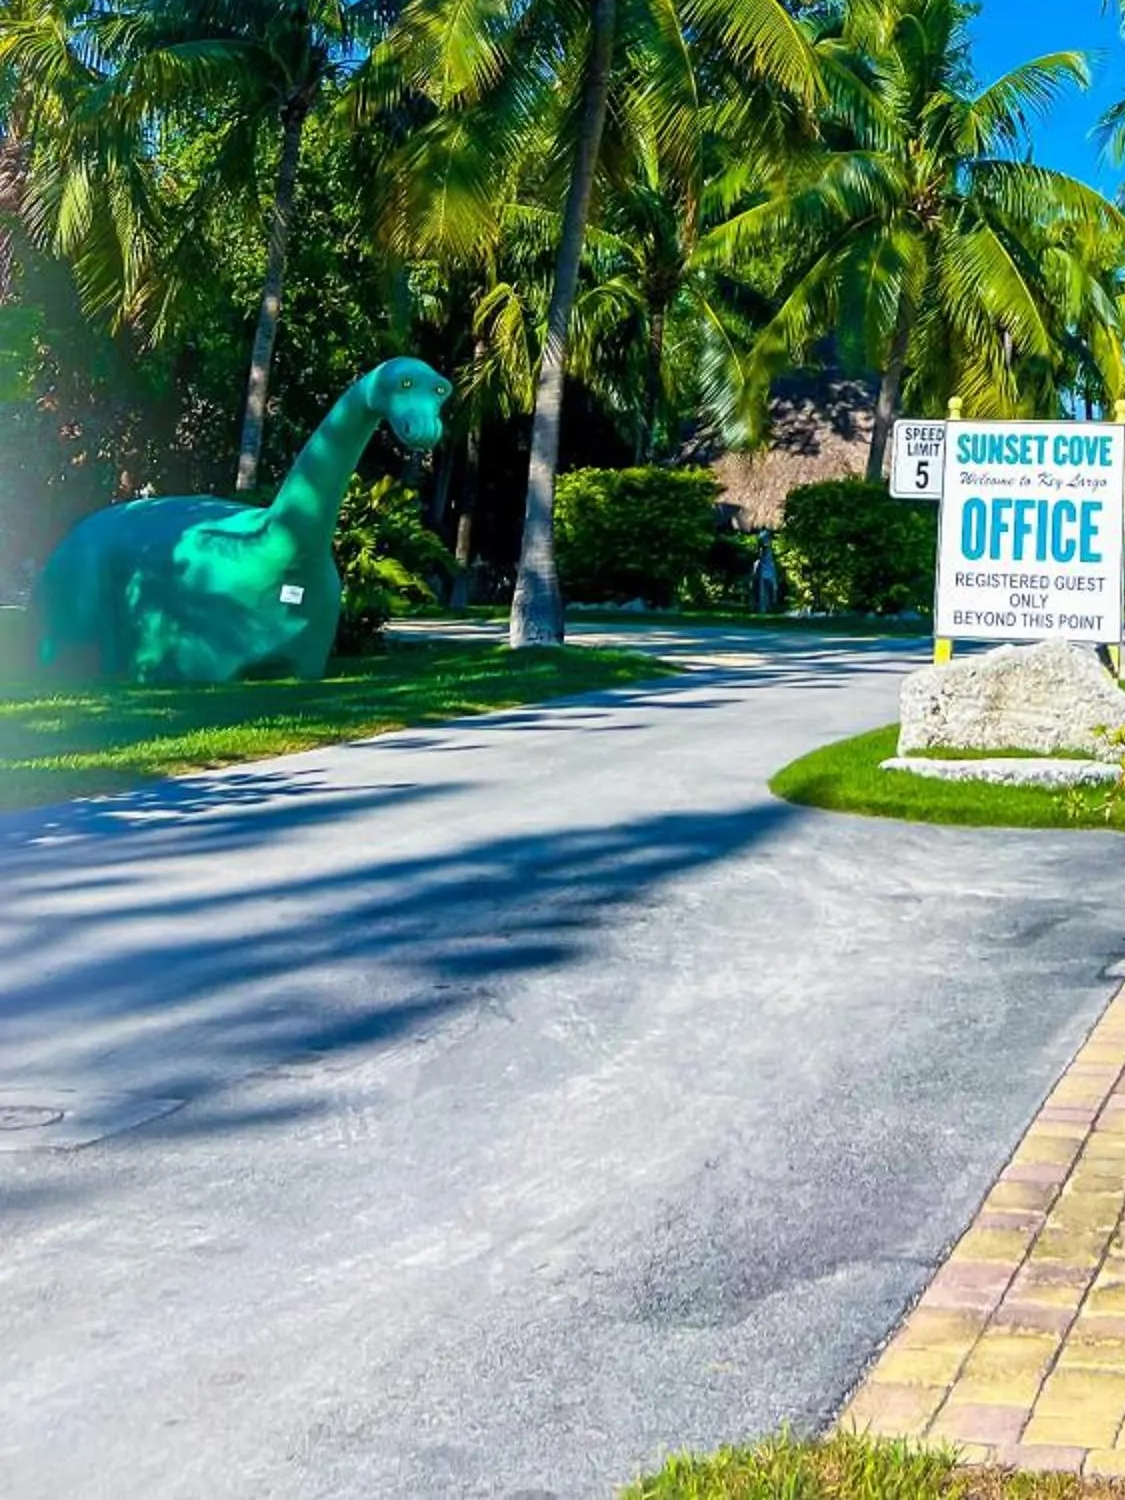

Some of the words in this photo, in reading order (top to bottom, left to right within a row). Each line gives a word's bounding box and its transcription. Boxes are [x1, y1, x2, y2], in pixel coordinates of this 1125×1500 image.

[905, 427, 945, 441] SPEED
[907, 442, 941, 457] LIMIT
[957, 433, 1048, 466] SUNSET
[1053, 435, 1113, 467] COVE
[915, 461, 929, 489] 5
[960, 471, 1015, 487] Welcome
[1019, 473, 1031, 487] to
[1037, 474, 1063, 490] Key
[1066, 473, 1108, 492] Largo
[961, 497, 1103, 563] OFFICE
[955, 572, 1050, 589] REGISTERED
[1054, 576, 1106, 592] GUEST
[1009, 593, 1049, 609] ONLY
[953, 610, 1017, 627] BEYOND
[1021, 613, 1054, 629] THIS
[1058, 614, 1105, 631] POINT
